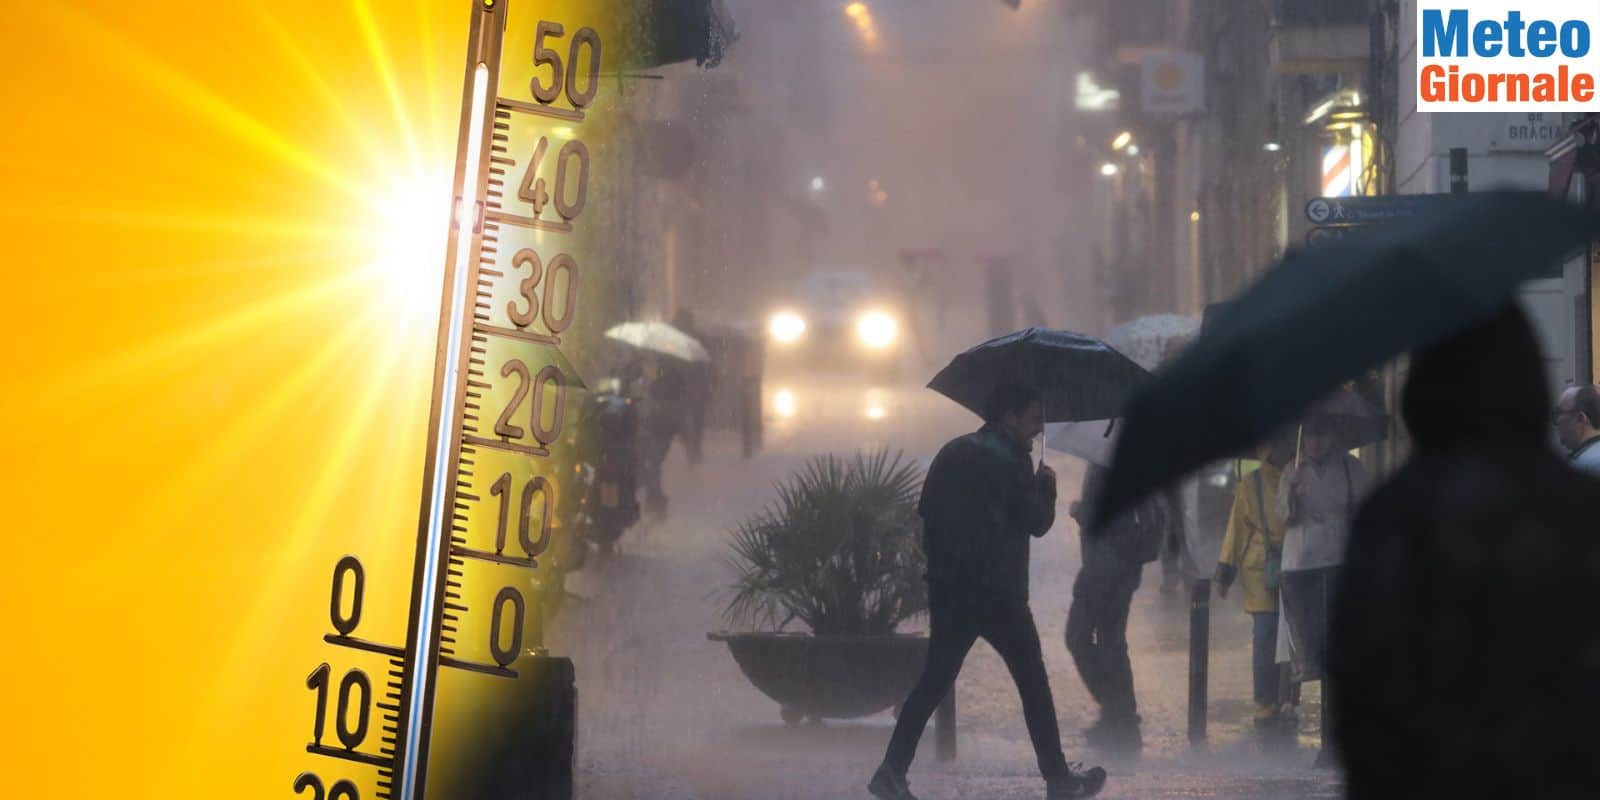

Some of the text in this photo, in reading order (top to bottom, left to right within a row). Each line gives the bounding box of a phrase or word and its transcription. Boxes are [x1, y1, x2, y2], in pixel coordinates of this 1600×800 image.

[530, 20, 601, 108] 50
[518, 136, 590, 221] 40
[507, 248, 578, 333] 30
[494, 359, 566, 444] 20
[490, 472, 555, 557] 10
[330, 555, 365, 634] 0
[490, 586, 525, 667] 0
[306, 662, 371, 749] 10
